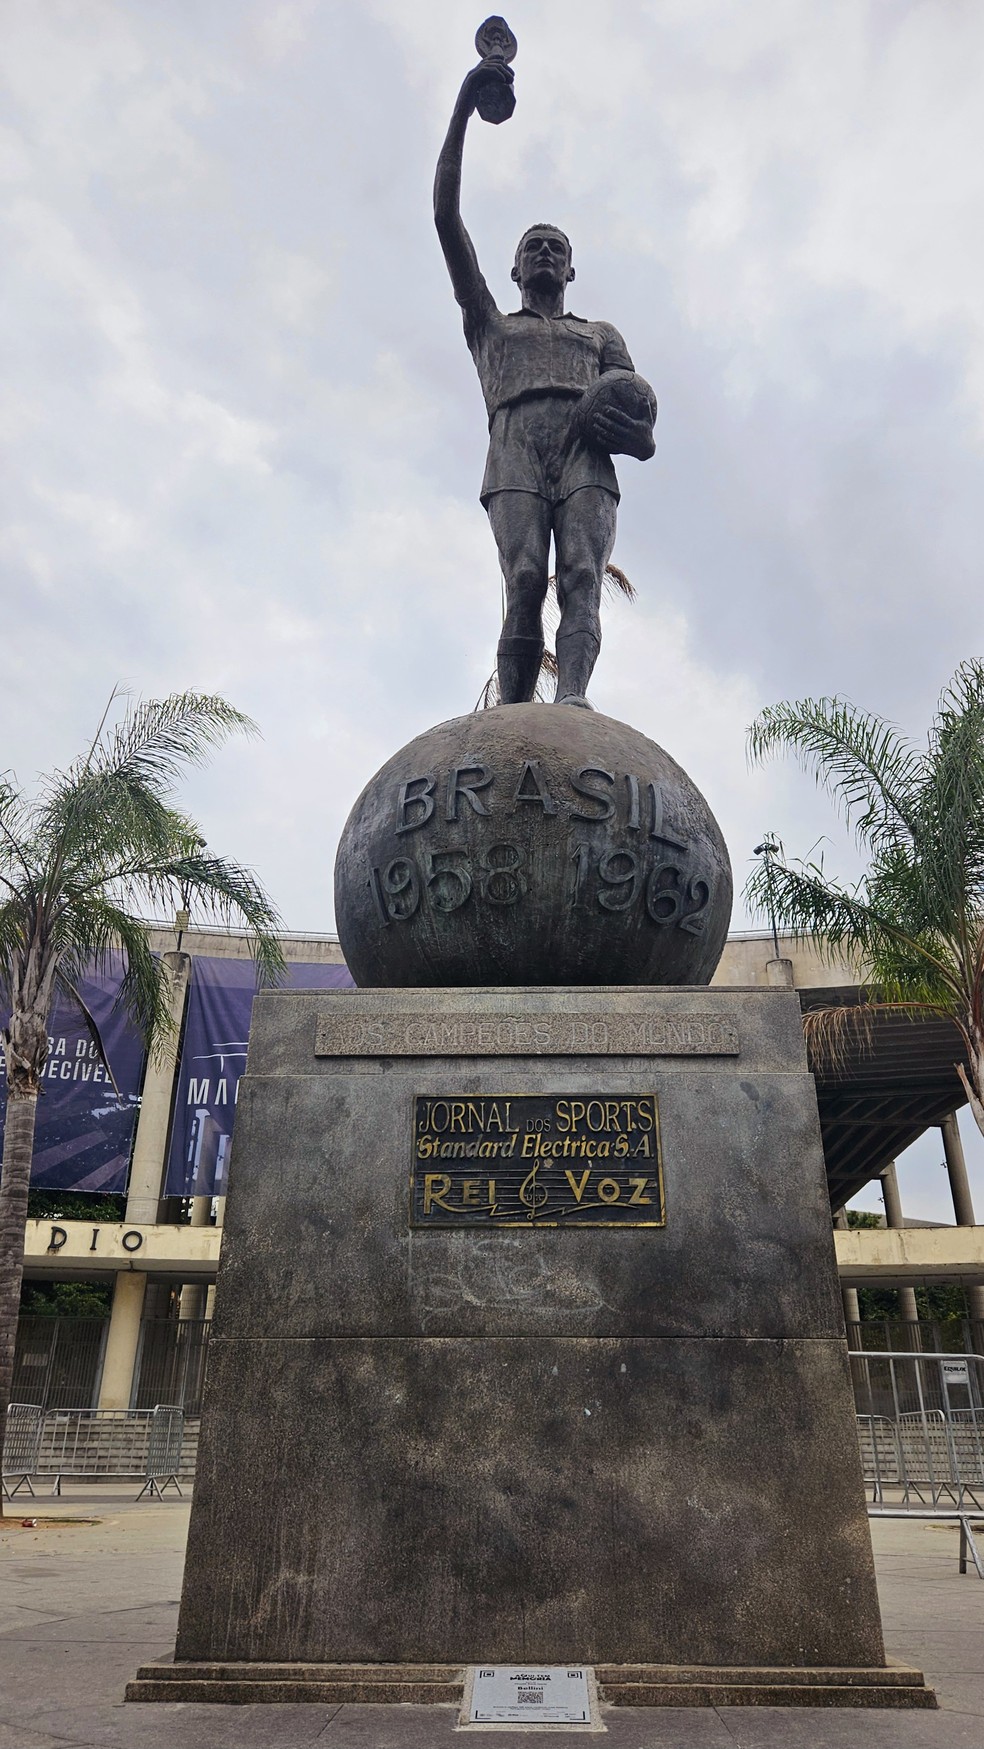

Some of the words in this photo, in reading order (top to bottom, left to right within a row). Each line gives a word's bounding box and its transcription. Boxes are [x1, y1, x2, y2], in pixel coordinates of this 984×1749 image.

[395, 759, 689, 850] BRASIL
[367, 842, 528, 929] 1958
[570, 841, 713, 936] 1962
[571, 1022, 608, 1046] DO
[187, 1078, 240, 1105] MA
[418, 1101, 520, 1133] JORNAL
[526, 1118, 551, 1133] DOS
[555, 1100, 653, 1133] SPORTS
[416, 1133, 518, 1159] Standard
[520, 1133, 610, 1159] Electrica
